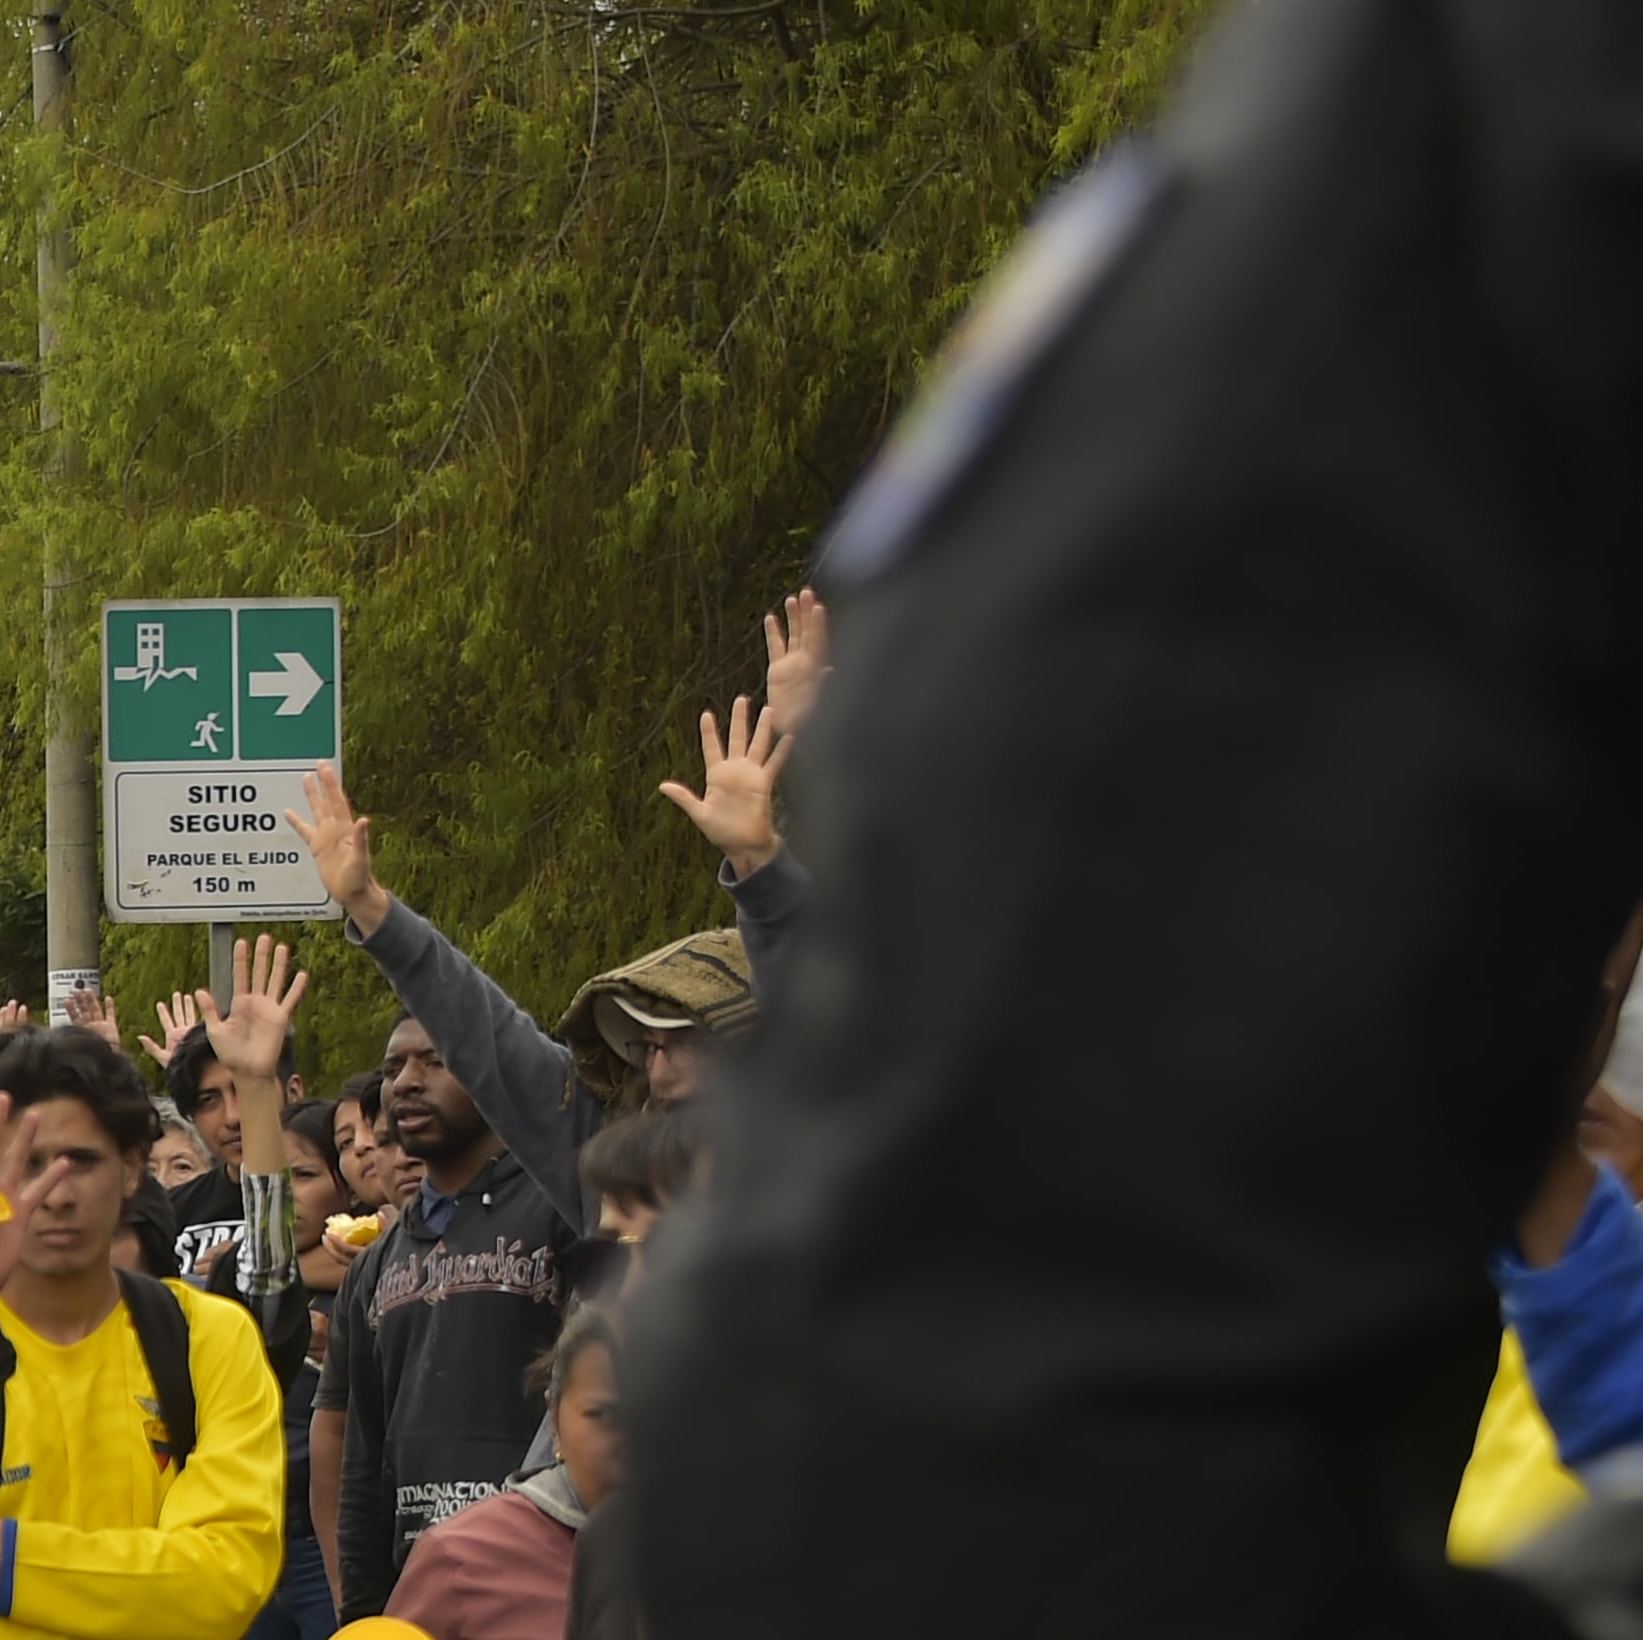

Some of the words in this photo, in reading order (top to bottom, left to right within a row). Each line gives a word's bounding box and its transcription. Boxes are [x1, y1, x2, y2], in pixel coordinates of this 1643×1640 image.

[188, 784, 257, 803] SITIO
[169, 813, 277, 833] SEGURO
[147, 853, 216, 866] PARQUE
[222, 853, 243, 865] EL
[248, 852, 300, 864] EJIDO
[192, 877, 230, 893] 150
[237, 880, 256, 892] m
